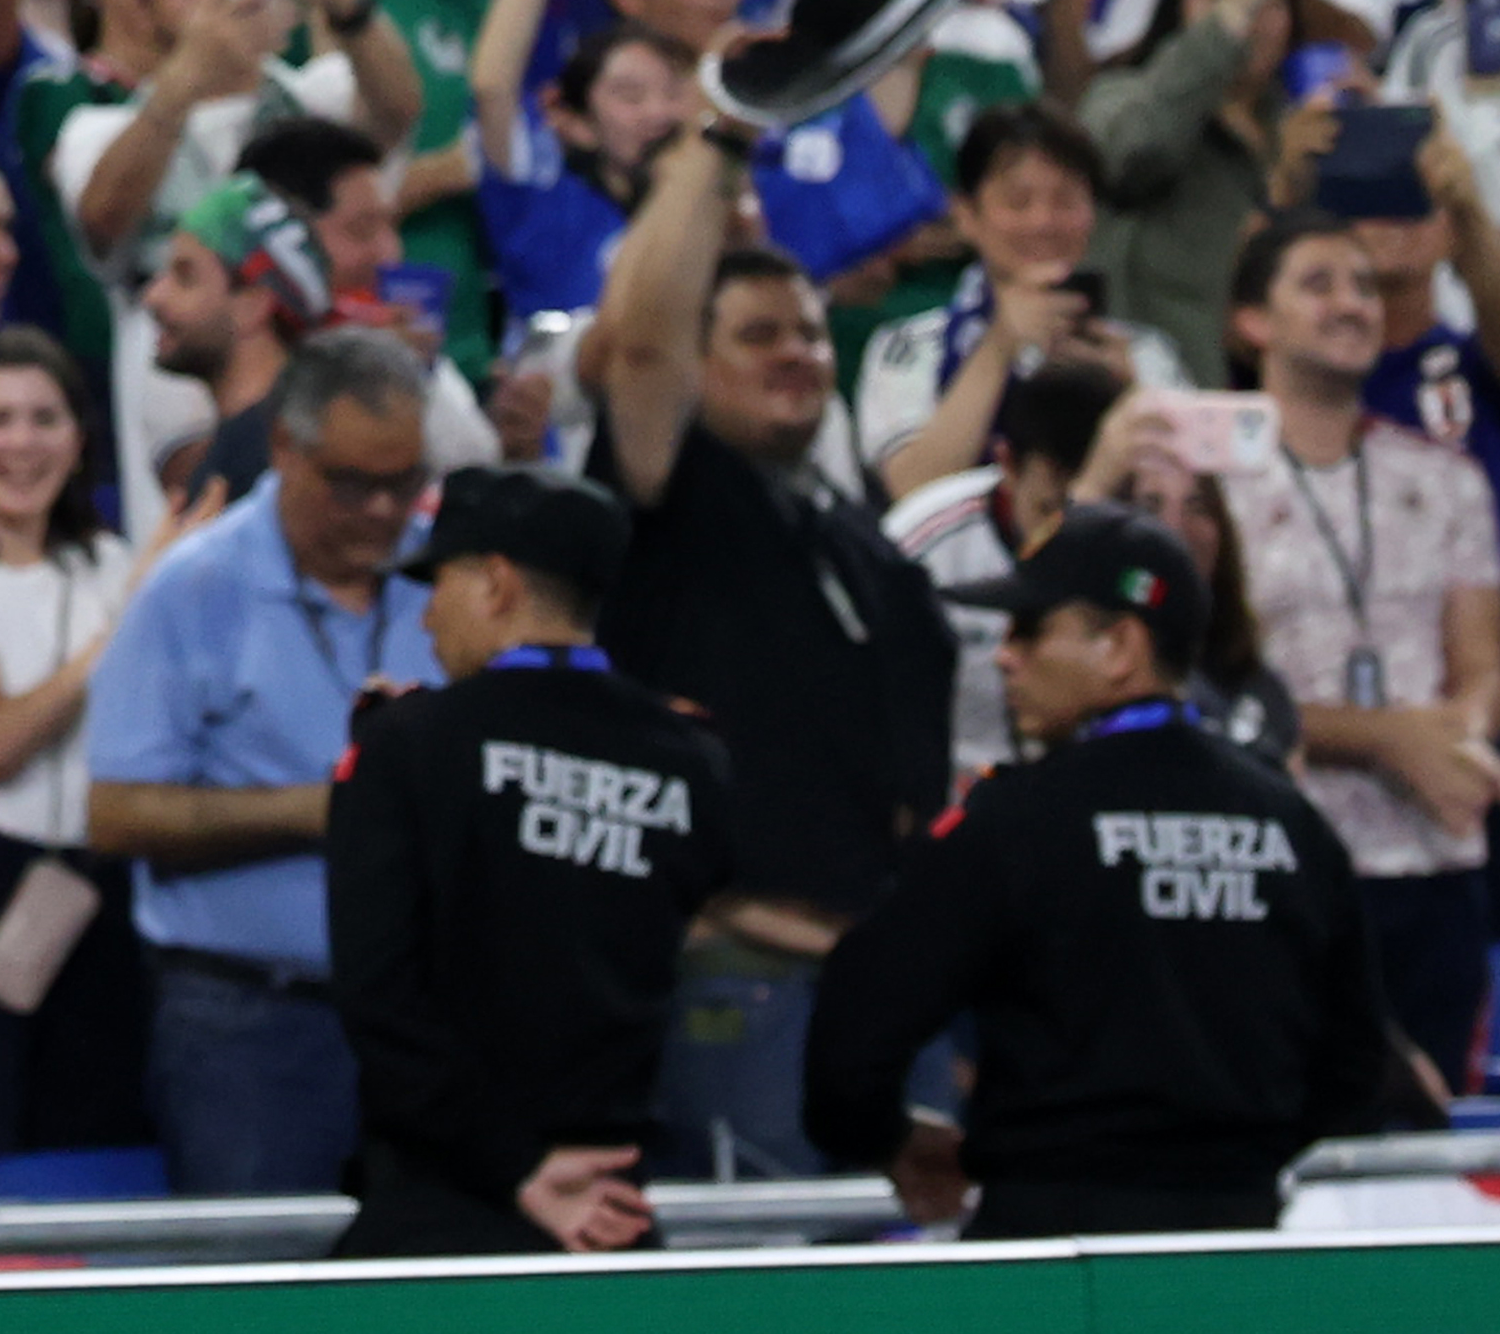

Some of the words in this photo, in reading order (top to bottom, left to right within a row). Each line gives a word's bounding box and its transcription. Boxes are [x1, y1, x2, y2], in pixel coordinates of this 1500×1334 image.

[478, 740, 693, 836] FUERZA
[518, 801, 653, 878] CIVIL
[1092, 811, 1298, 874] FUERZA
[1140, 868, 1269, 921] CIVIL
